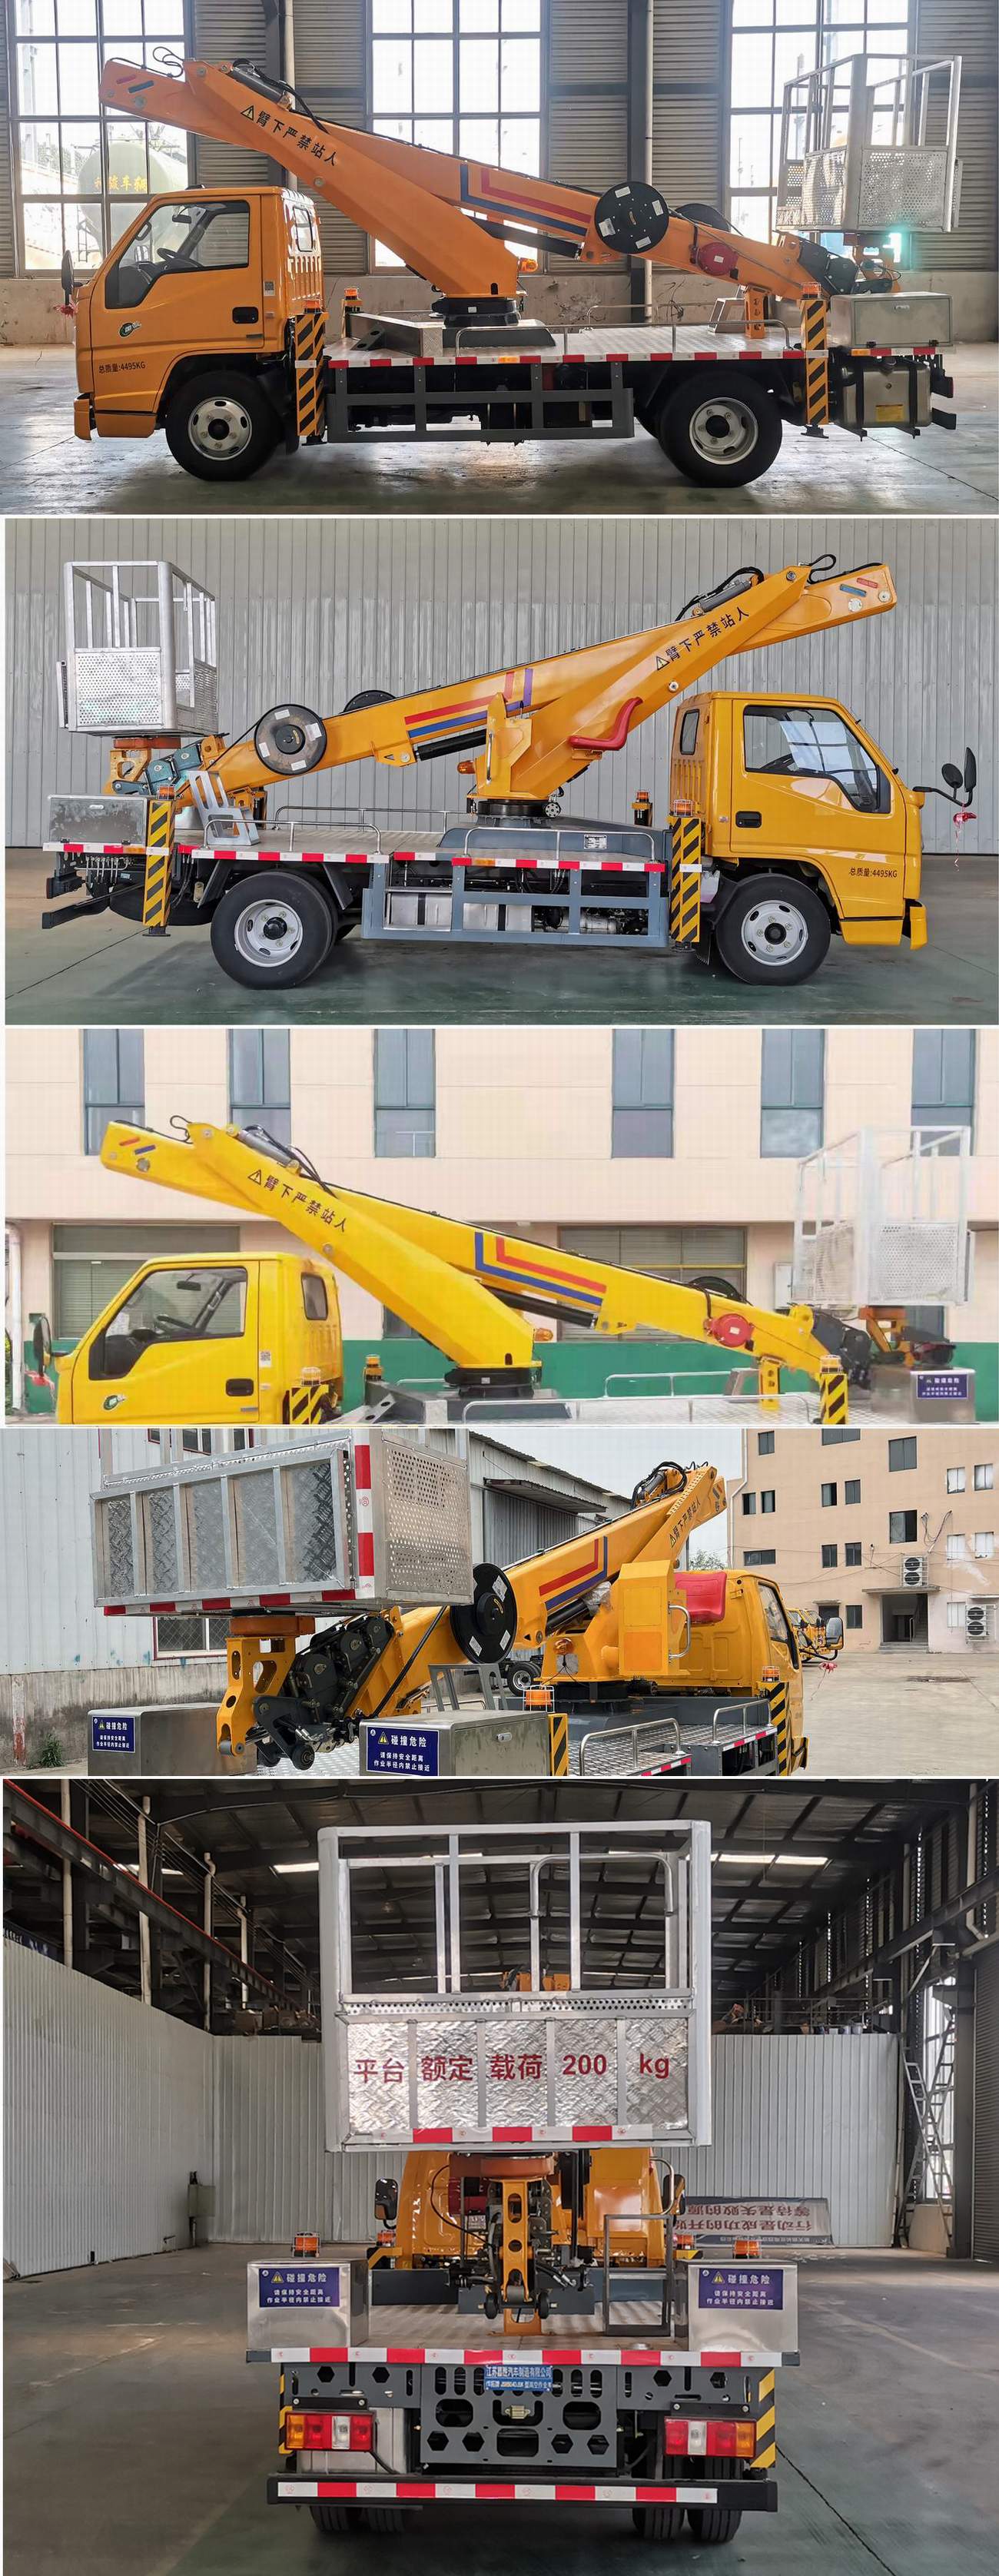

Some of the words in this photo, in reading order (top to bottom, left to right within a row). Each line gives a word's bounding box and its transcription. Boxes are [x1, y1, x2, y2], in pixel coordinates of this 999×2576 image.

[256, 110, 337, 167] 臂下严禁站人
[665, 606, 749, 662] 臂下严禁站人
[849, 867, 898, 878] 总质量:4495KG
[264, 1174, 347, 1233] 臂下严禁站人
[390, 1734, 426, 1748] 碰撞危险
[380, 1751, 423, 1762] 请保持安全距离
[373, 1760, 430, 1772] 作业半径内禁止接近
[353, 2057, 405, 2083] 平台
[421, 2054, 473, 2082] 额定
[490, 2053, 543, 2080] 载荷
[563, 2054, 607, 2075] 200
[639, 2053, 670, 2079] kg
[687, 2204, 811, 2217] 等待是失败的源
[287, 2273, 327, 2282] 碰撞危险
[728, 2274, 770, 2284] 碰撞危险
